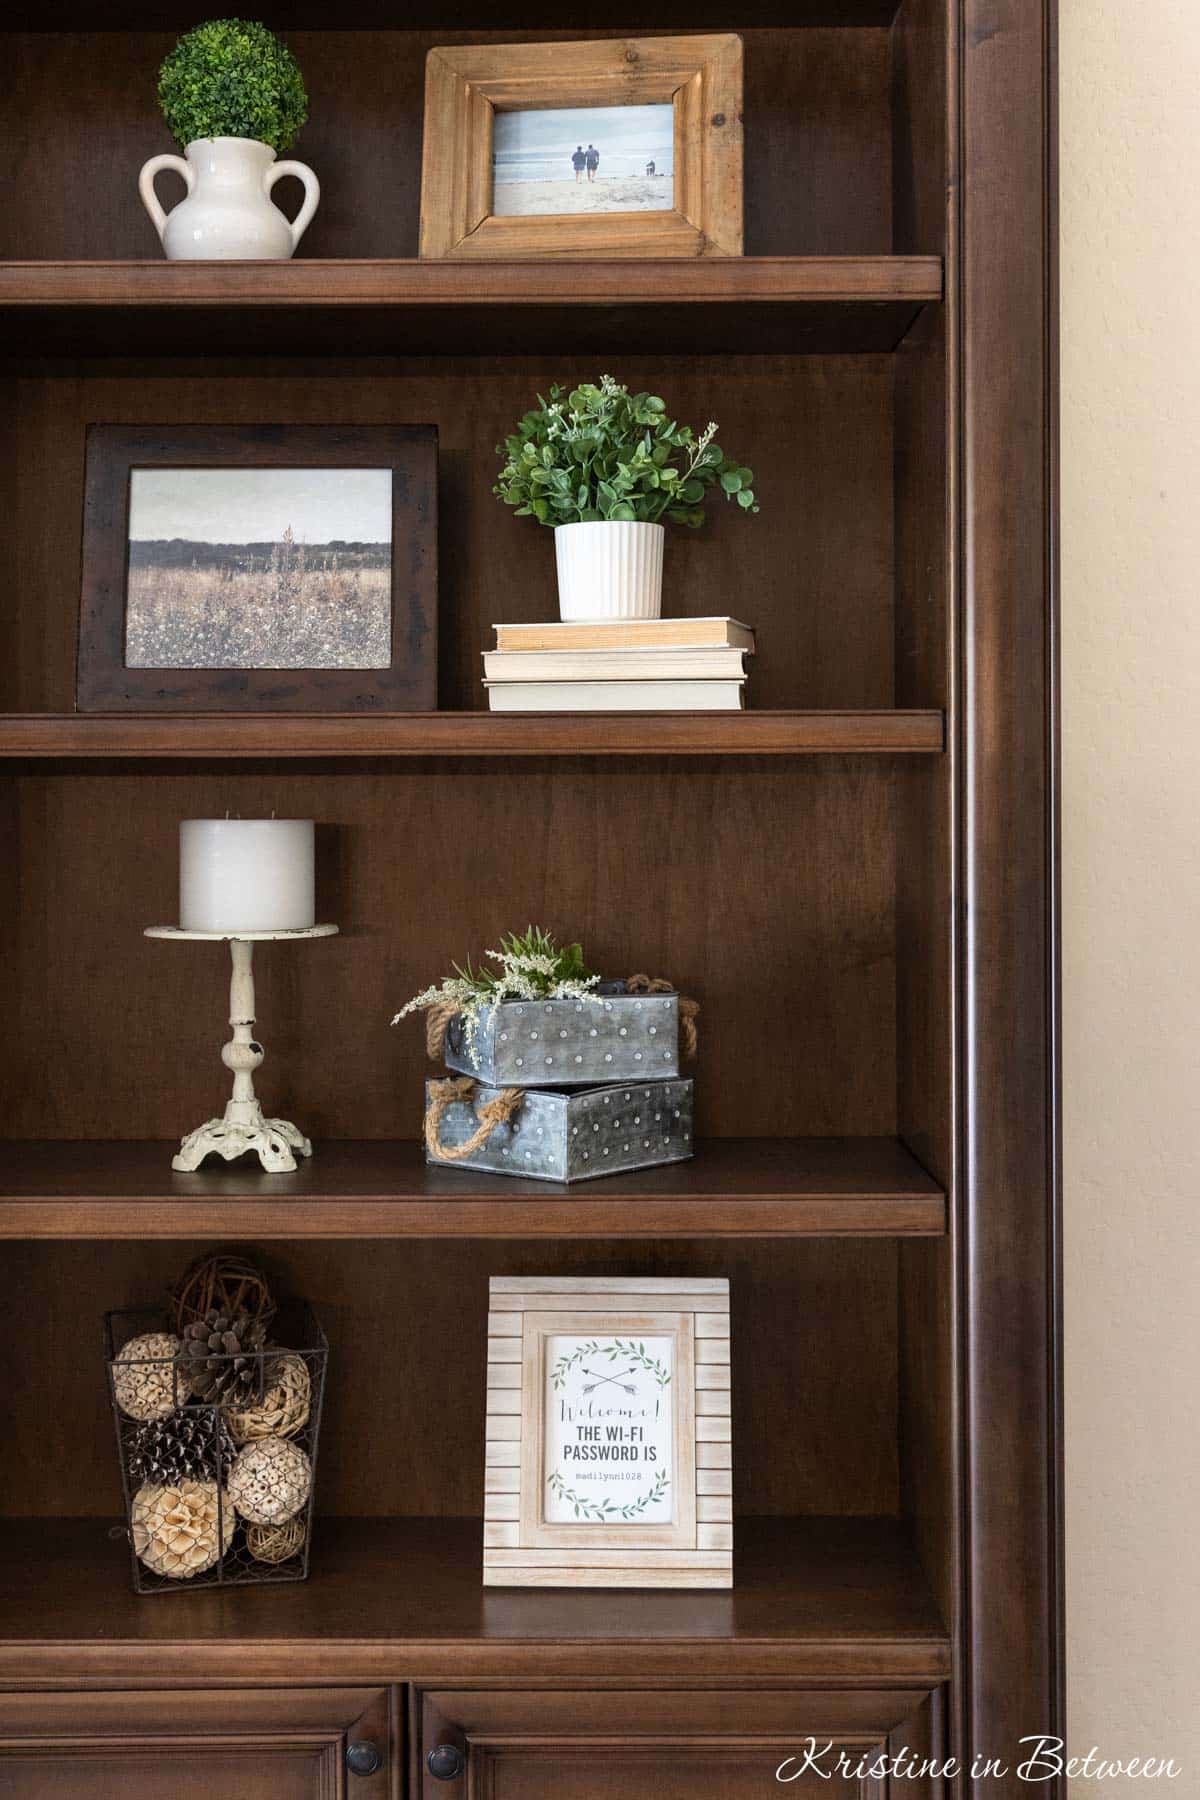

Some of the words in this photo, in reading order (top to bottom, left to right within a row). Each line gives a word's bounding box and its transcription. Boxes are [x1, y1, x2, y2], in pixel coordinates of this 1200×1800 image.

[576, 1426, 601, 1441] THE
[606, 1426, 643, 1442] WI-FI
[563, 1445, 638, 1461] PASSWORD
[644, 1446, 657, 1461] IS
